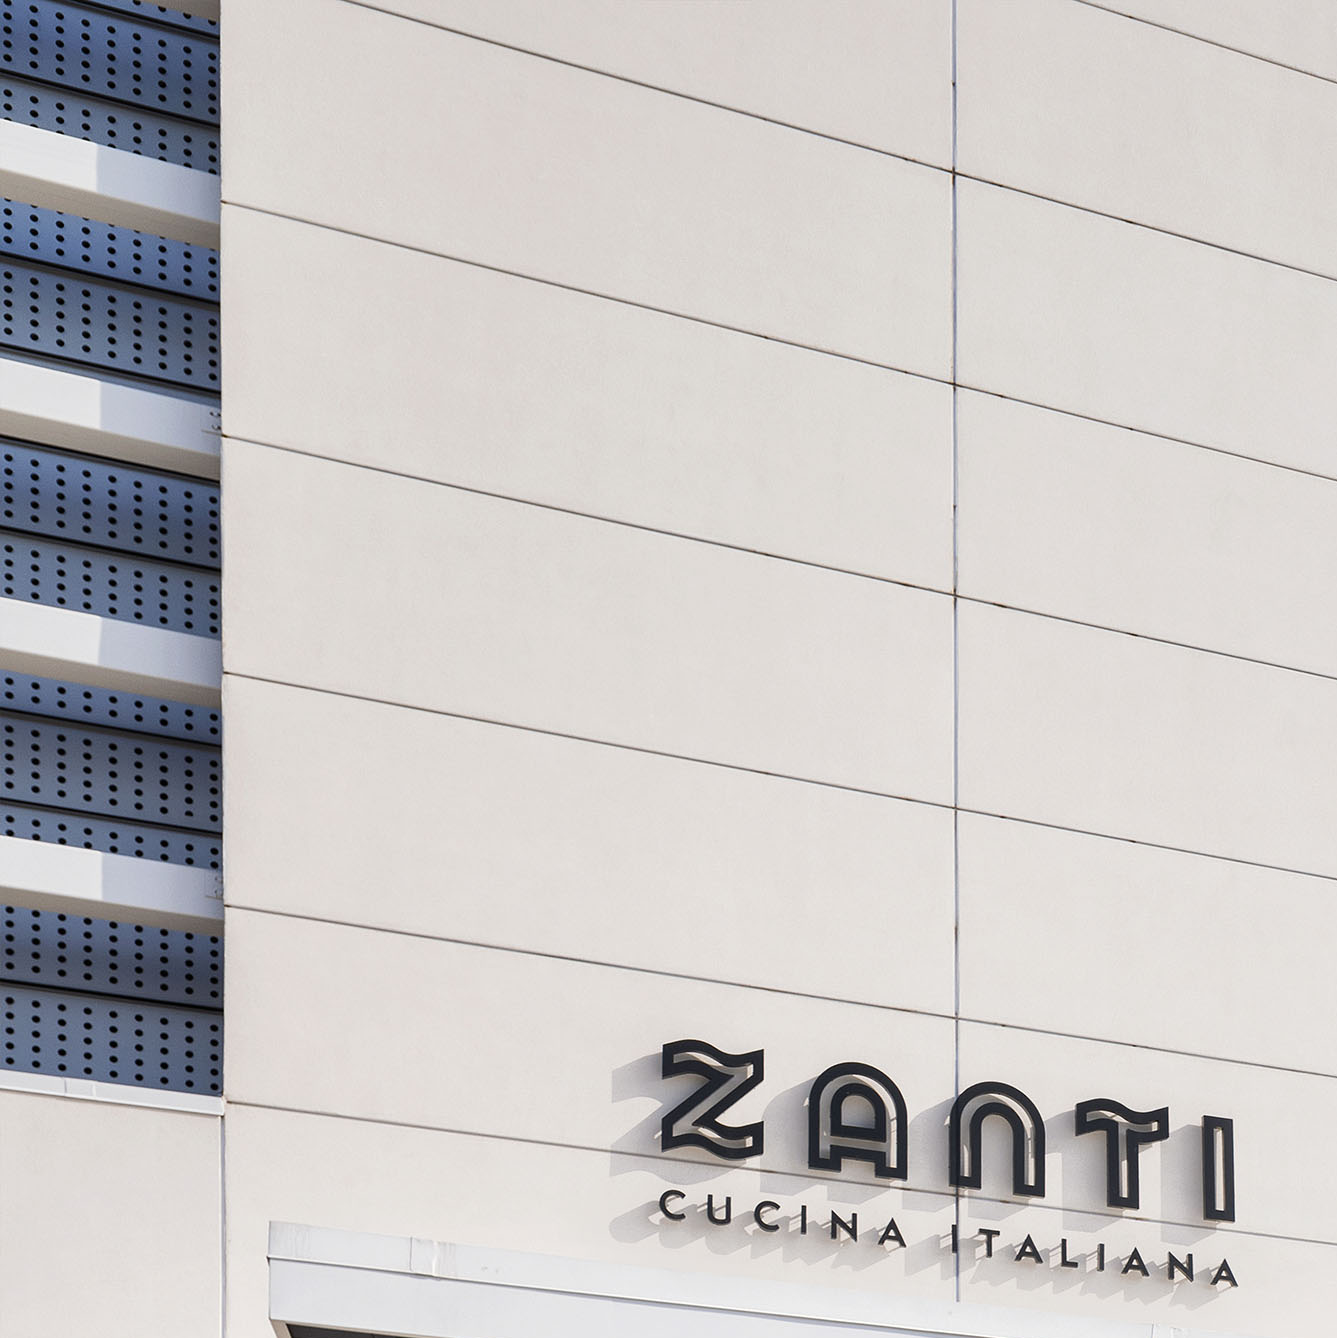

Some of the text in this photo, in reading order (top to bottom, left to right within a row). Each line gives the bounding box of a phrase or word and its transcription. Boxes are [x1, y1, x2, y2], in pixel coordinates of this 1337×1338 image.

[661, 1038, 1236, 1222] ZANTI
[658, 1188, 1239, 1288] CUCINA ITALIANA
